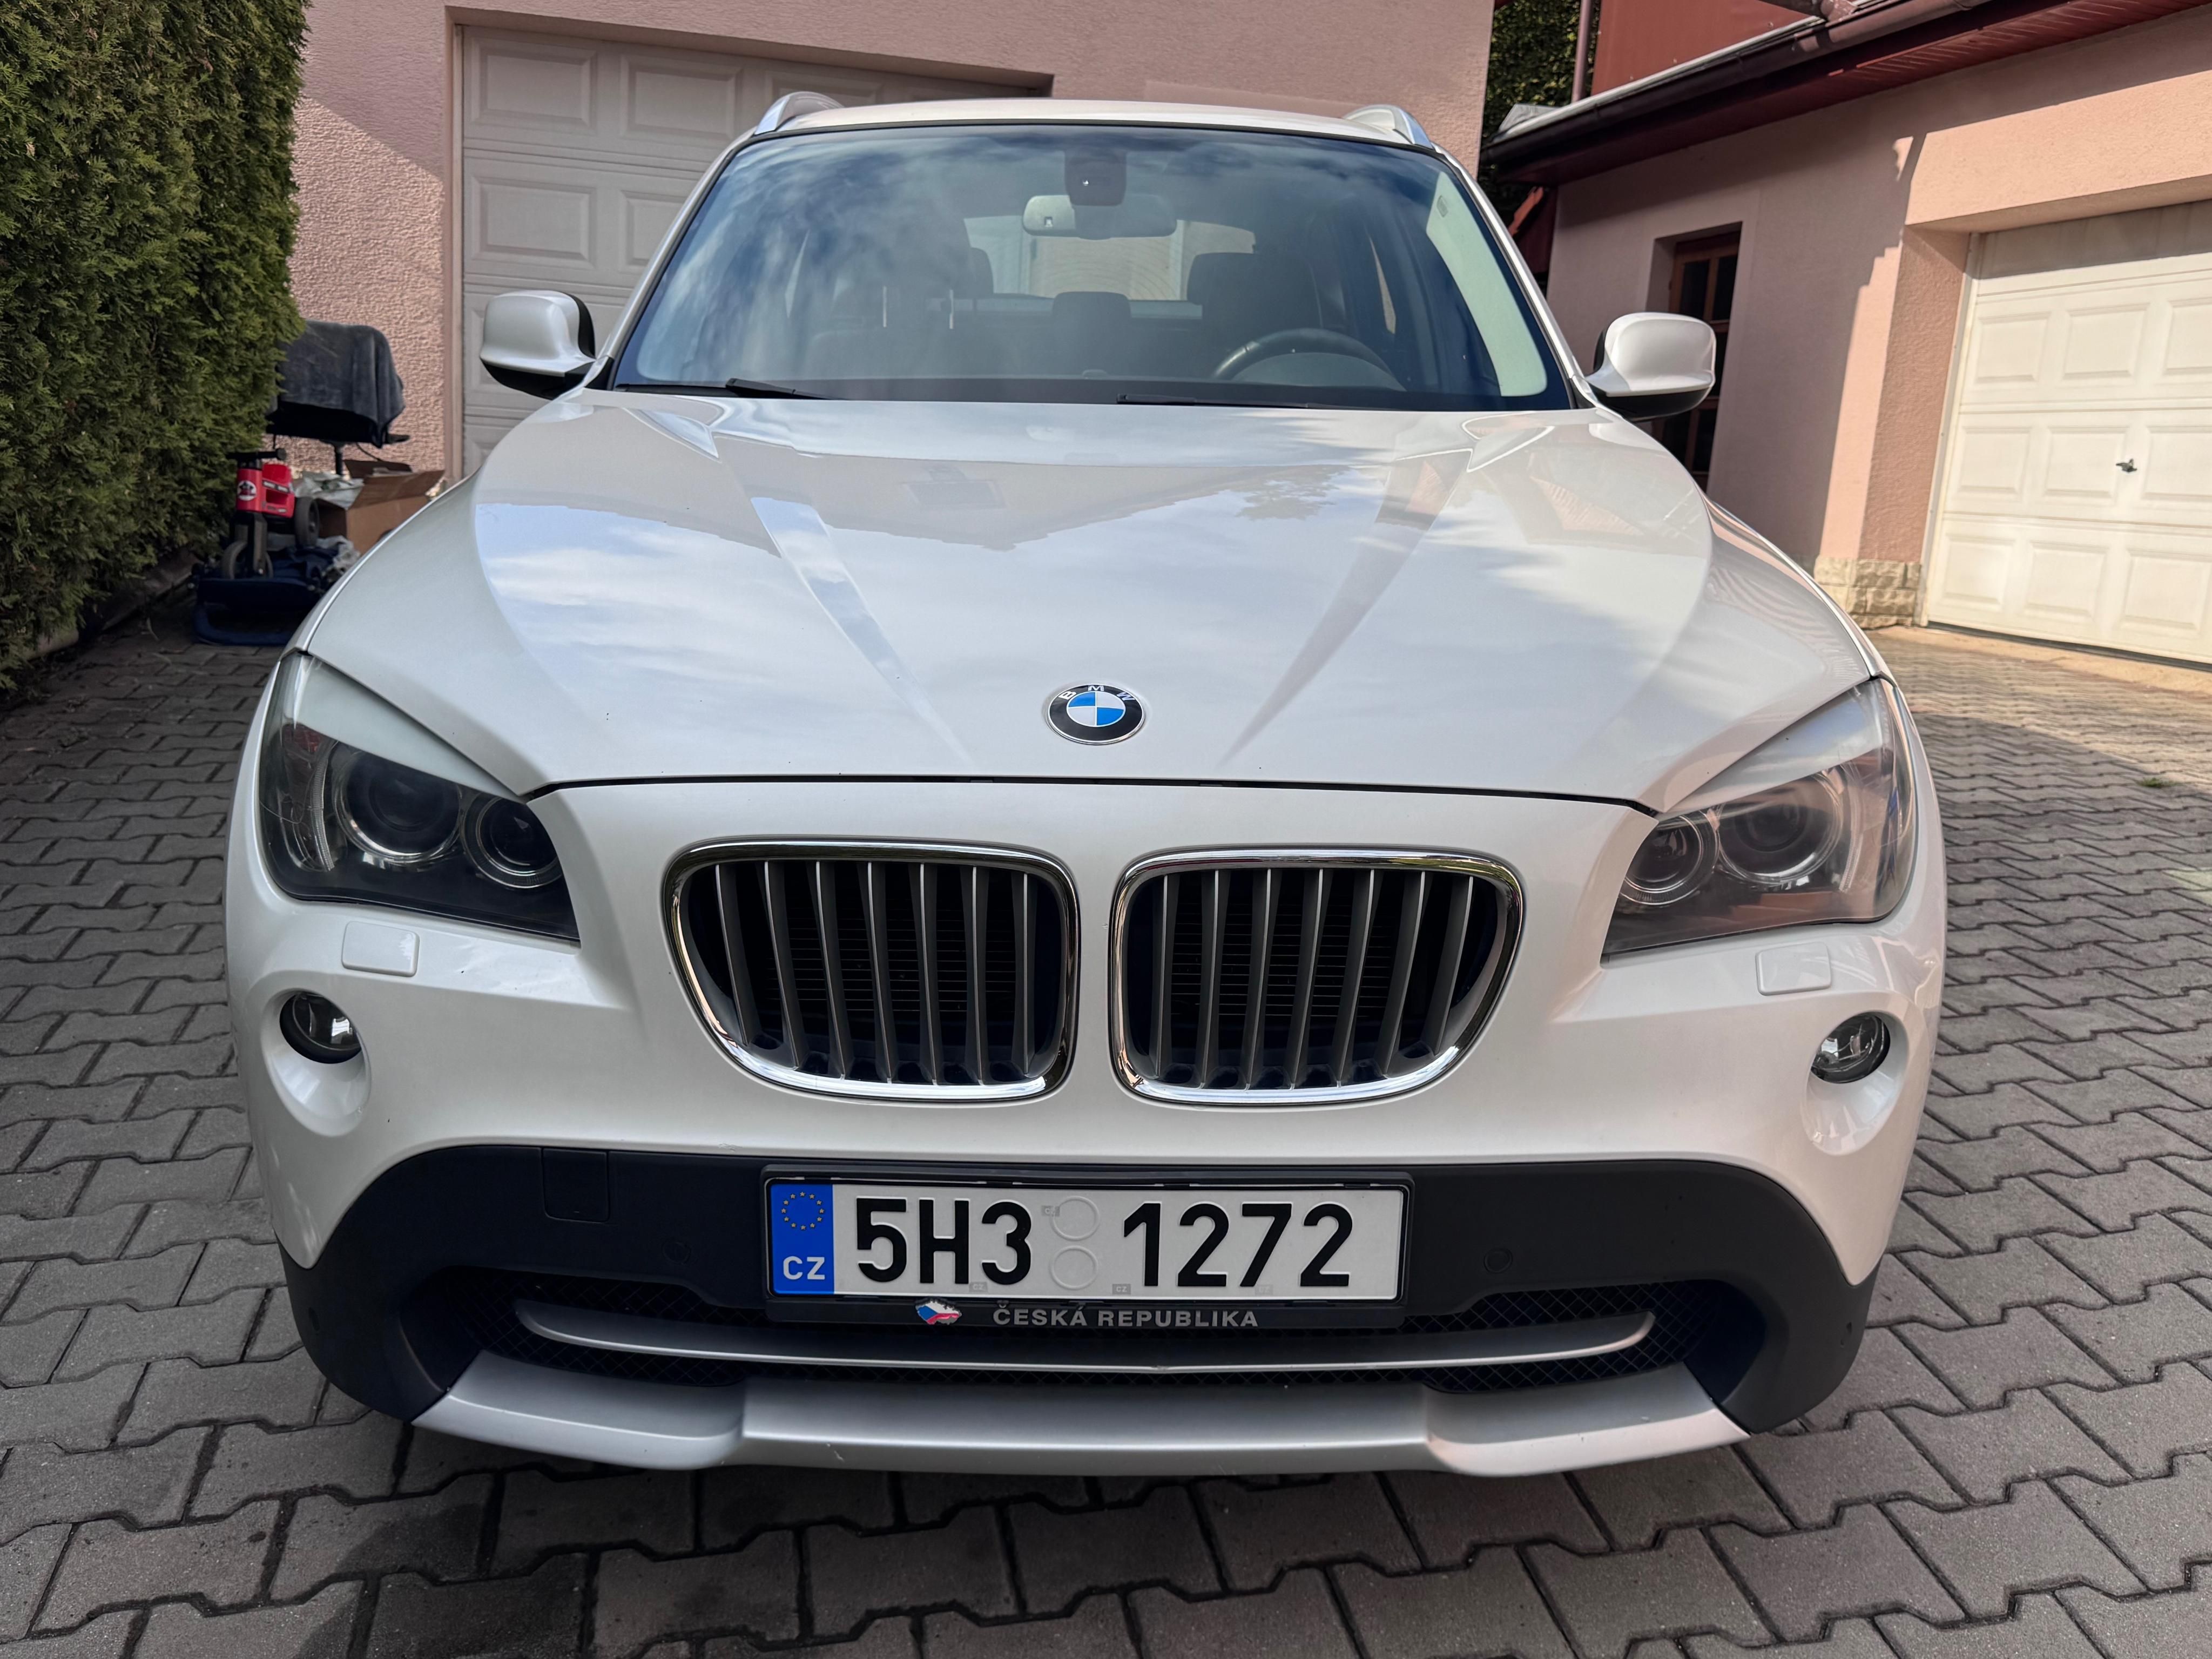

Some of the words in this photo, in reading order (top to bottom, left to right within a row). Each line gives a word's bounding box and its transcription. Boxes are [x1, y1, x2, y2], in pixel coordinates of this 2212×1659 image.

[1058, 685, 1135, 701] BMW
[857, 1197, 1031, 1285] 5H3
[1123, 1202, 1353, 1287] 1272
[783, 1256, 825, 1280] CZ
[993, 1303, 1088, 1326] ČESKÁ
[1098, 1310, 1259, 1327] REPUBLIKA
